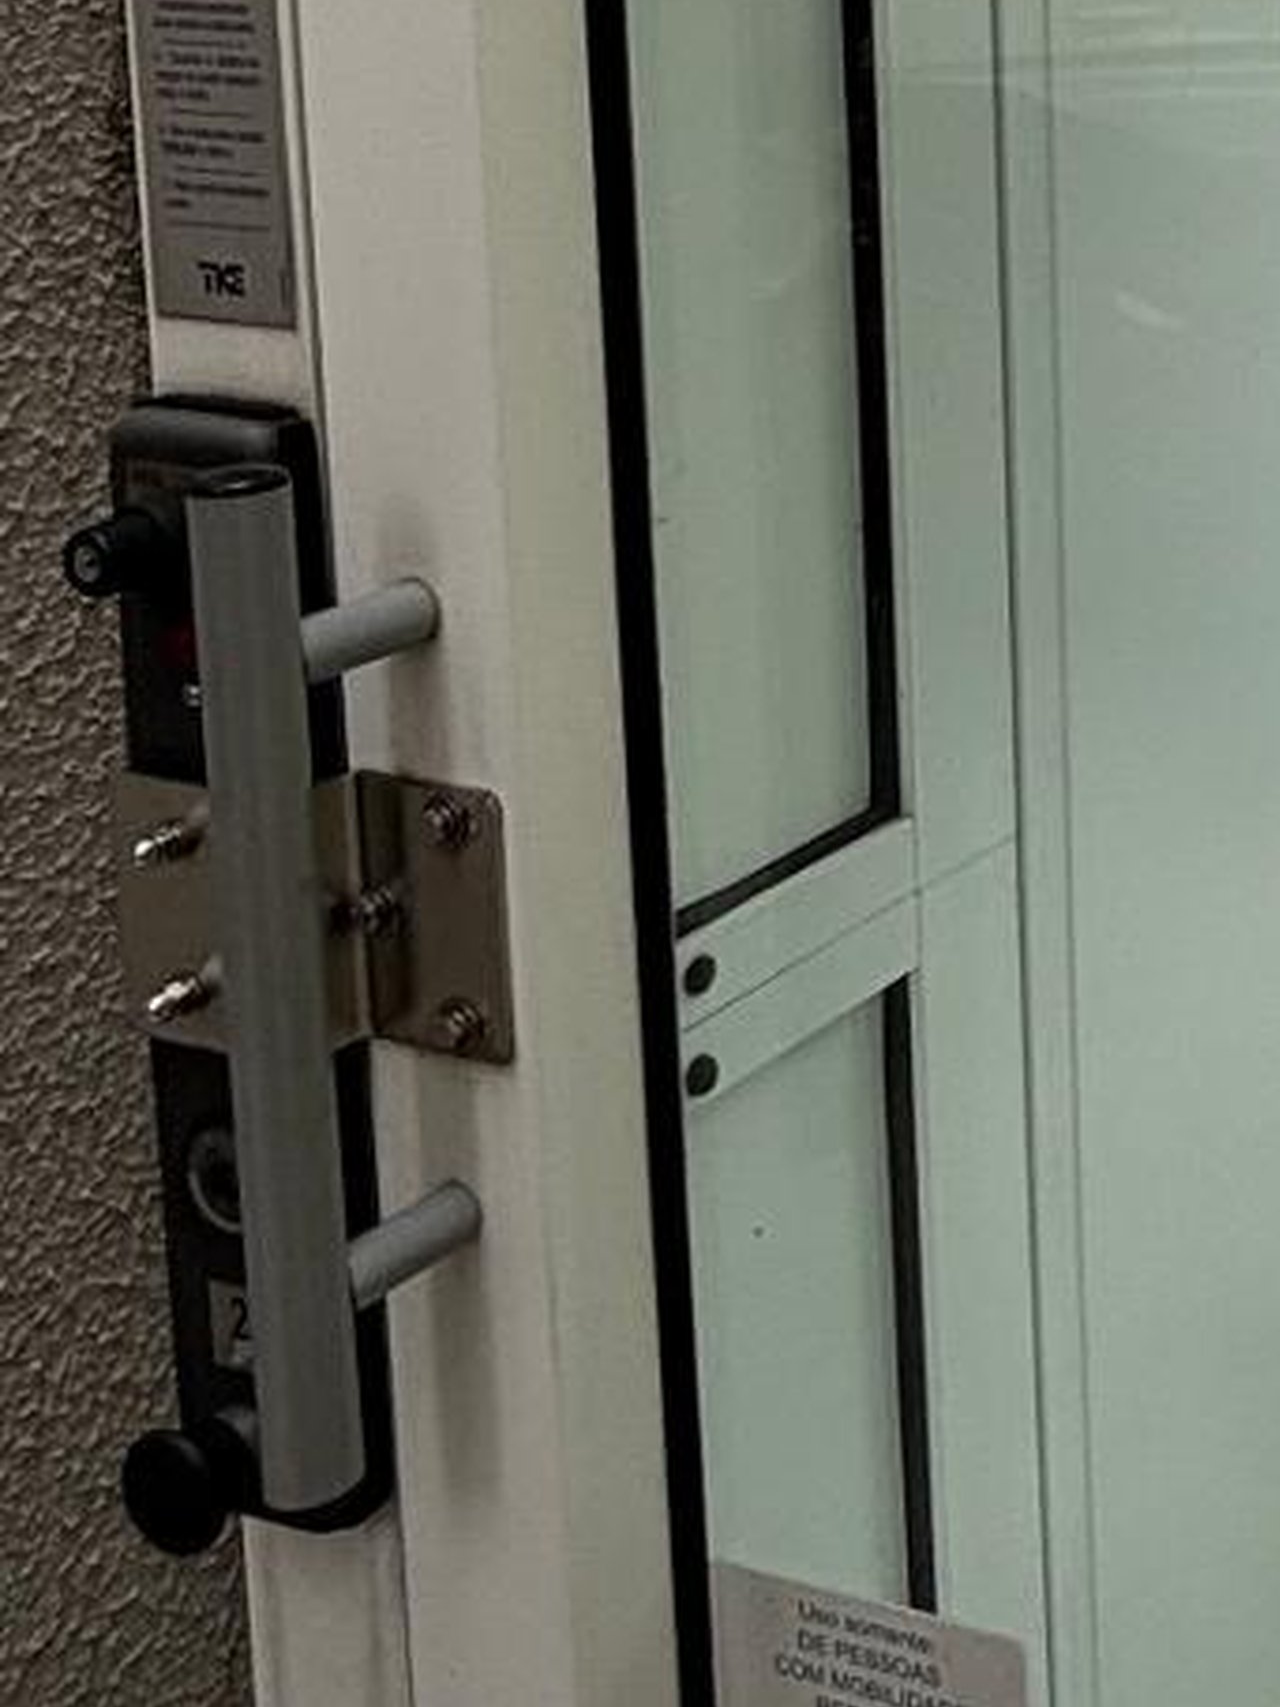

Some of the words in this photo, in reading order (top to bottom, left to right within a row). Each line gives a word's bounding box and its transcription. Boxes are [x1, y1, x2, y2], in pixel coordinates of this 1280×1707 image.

[197, 261, 245, 297] TKE
[775, 1652, 824, 1683] COM
[798, 1629, 829, 1656] DE
[836, 1640, 941, 1687] PESSOAS
